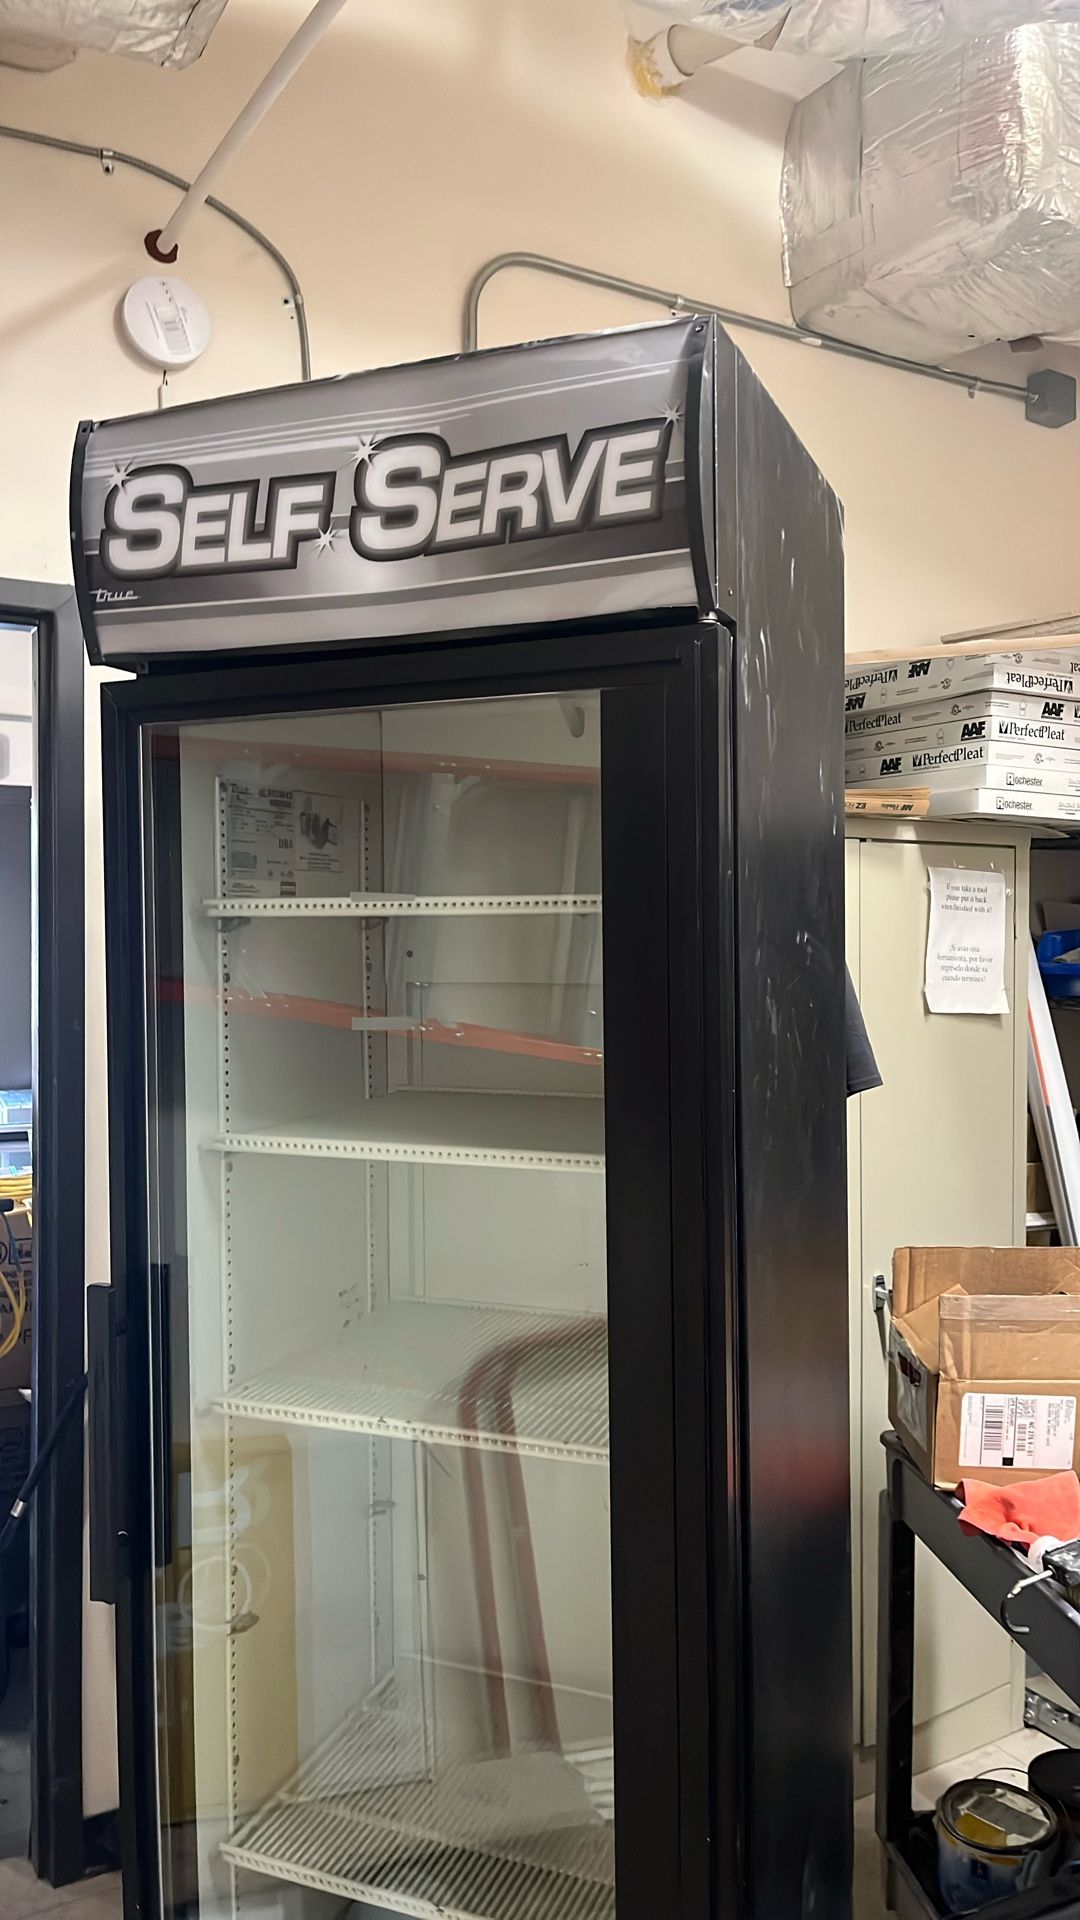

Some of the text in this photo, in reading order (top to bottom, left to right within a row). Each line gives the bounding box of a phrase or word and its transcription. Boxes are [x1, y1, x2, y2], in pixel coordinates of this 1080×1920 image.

[104, 424, 667, 575] SELF SERVE
[845, 660, 931, 690] AAF PerfectPle
[1006, 672, 1063, 692] PerfectPleat
[1041, 702, 1064, 717] AAF
[849, 712, 902, 732] PerfectPleat
[961, 721, 986, 738] AAF
[1009, 721, 1065, 740] PerfectPleat
[880, 757, 902, 773] AAF
[923, 747, 984, 766] PerfectPleat
[1006, 772, 1043, 786] Rochester
[996, 796, 1033, 810] Rochester
[951, 885, 960, 893] you
[961, 884, 972, 892] take
[977, 885, 988, 893] tool
[945, 894, 960, 902] please
[960, 895, 969, 903] put
[975, 895, 987, 903] back
[968, 956, 977, 964] por
[978, 955, 993, 963] favor
